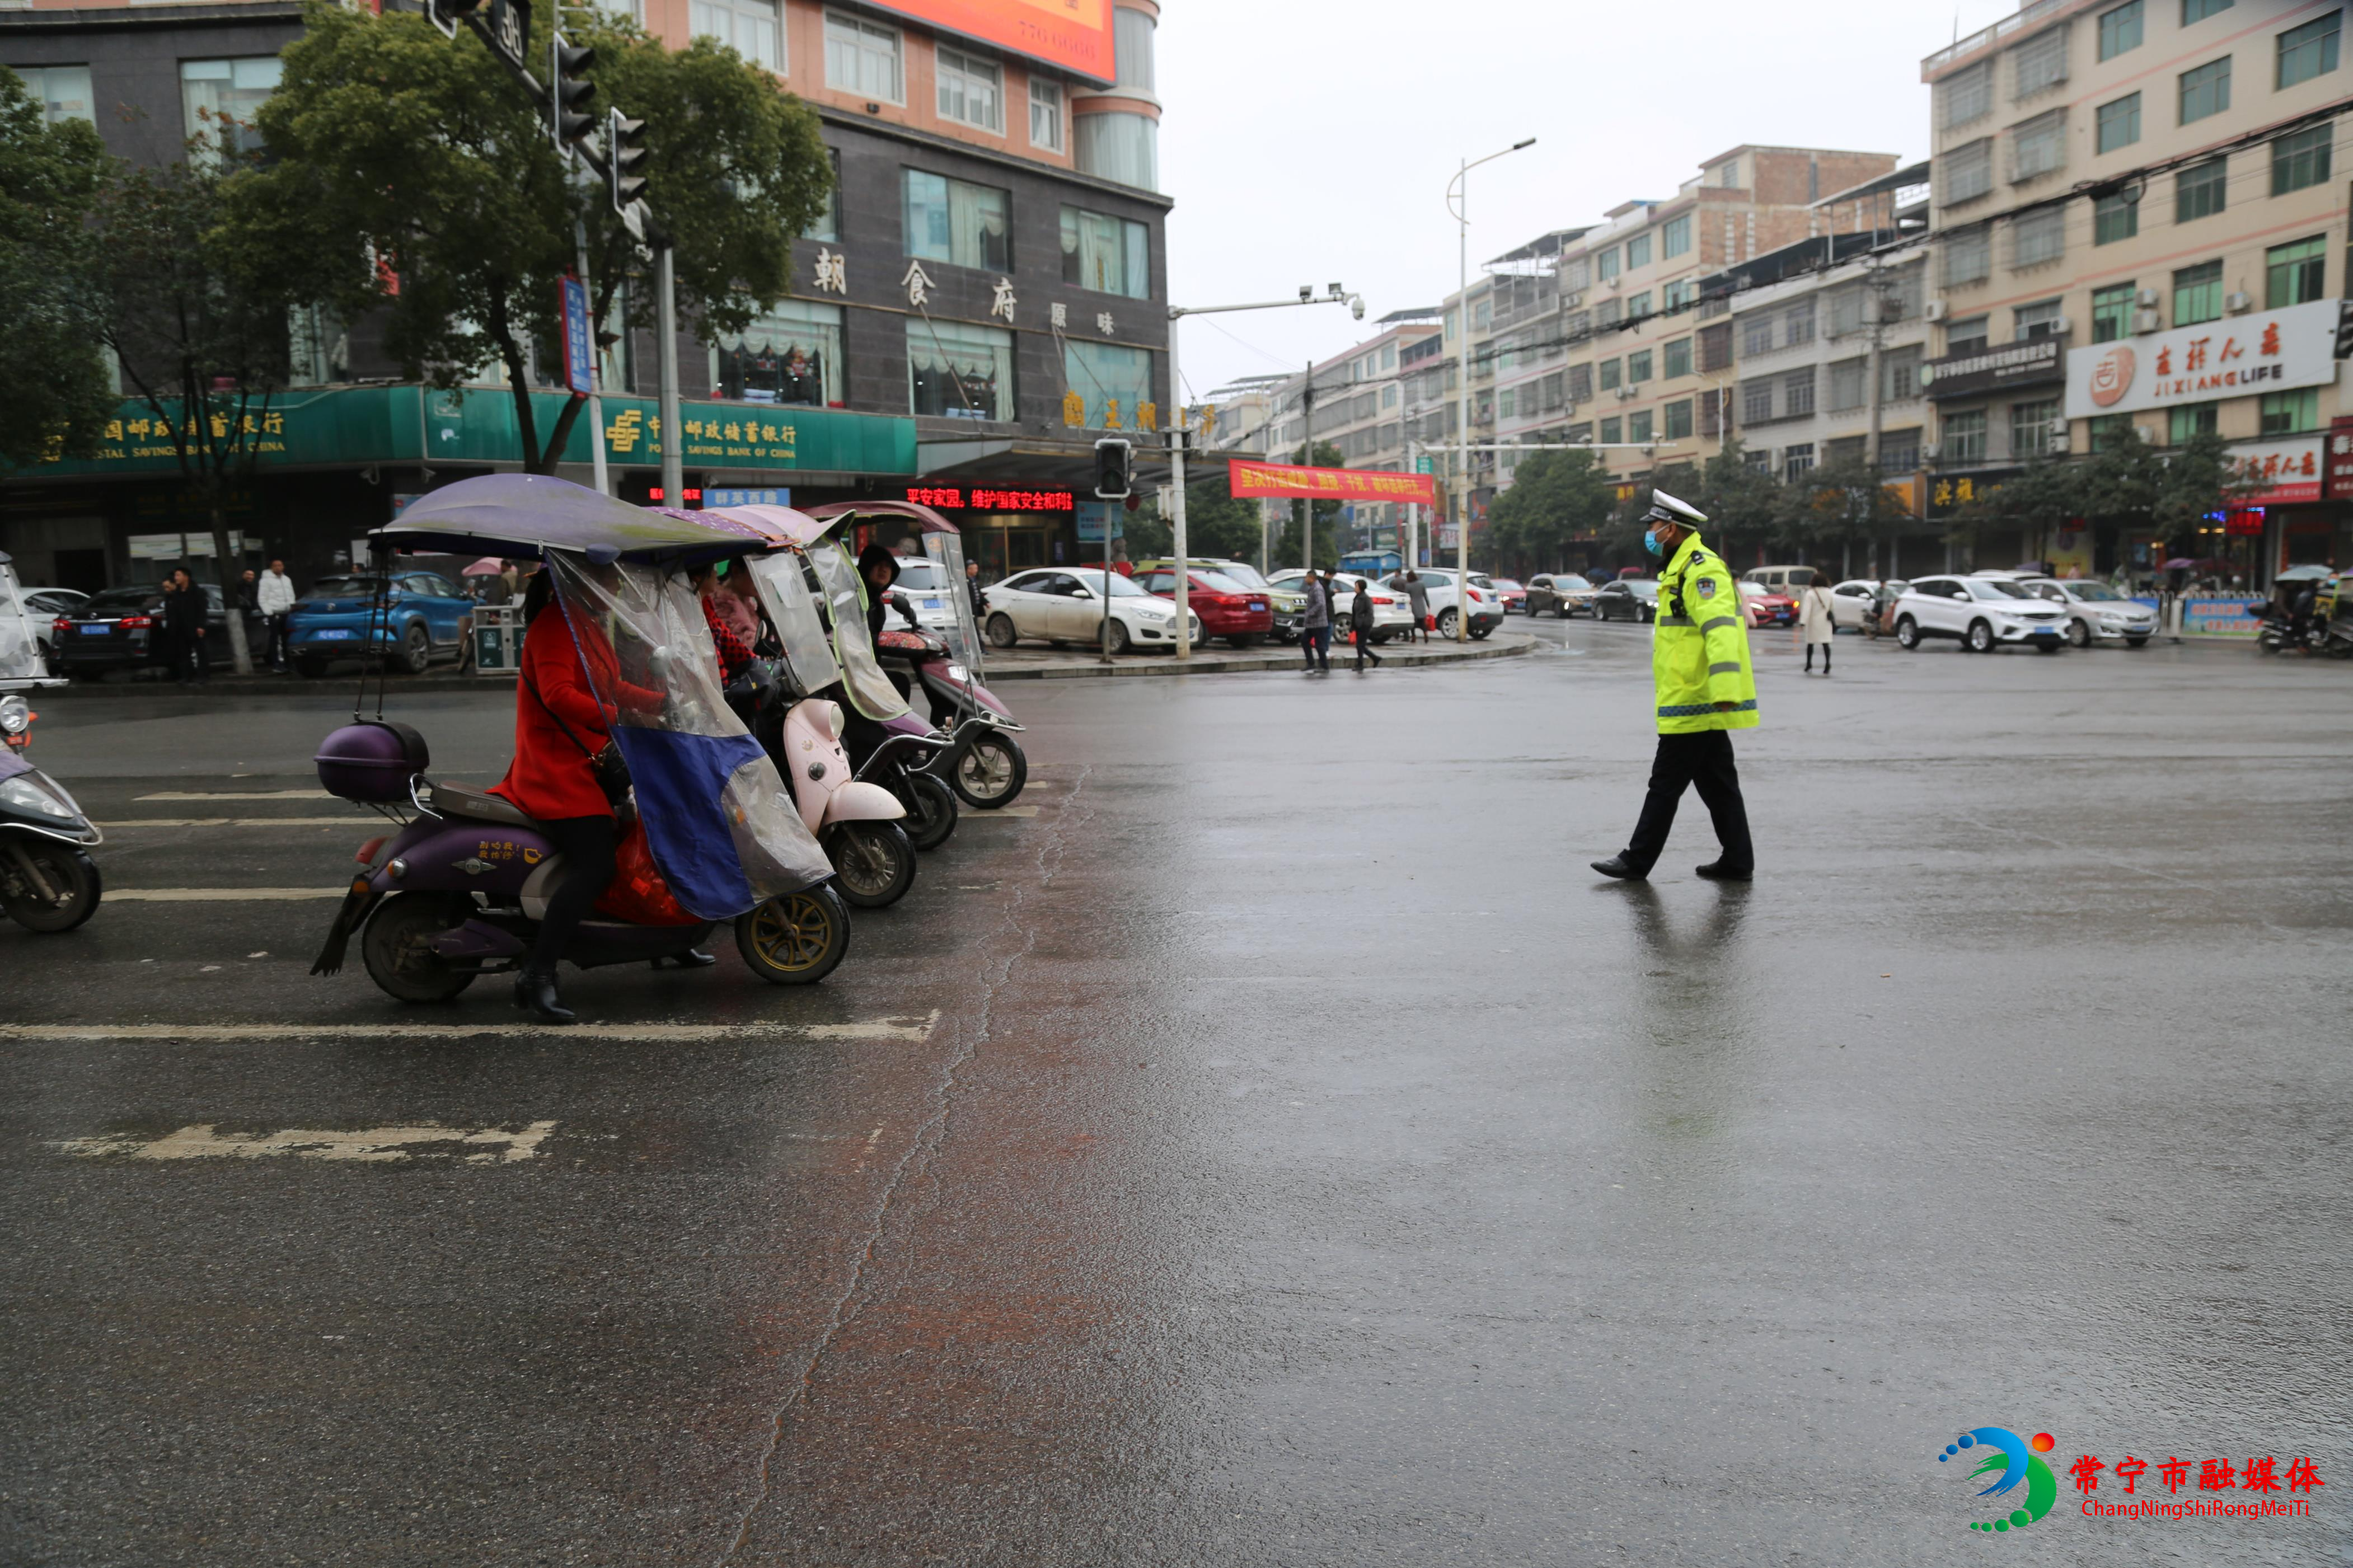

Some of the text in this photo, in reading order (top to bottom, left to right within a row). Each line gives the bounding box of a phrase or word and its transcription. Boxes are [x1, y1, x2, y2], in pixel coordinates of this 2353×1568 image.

[648, 415, 796, 444] 中邮政储蓄银行
[687, 445, 723, 456] SAVINGS
[727, 447, 751, 457] BANK
[754, 448, 766, 457] OF
[770, 449, 796, 458] CHINA
[715, 490, 777, 505] 群英西路
